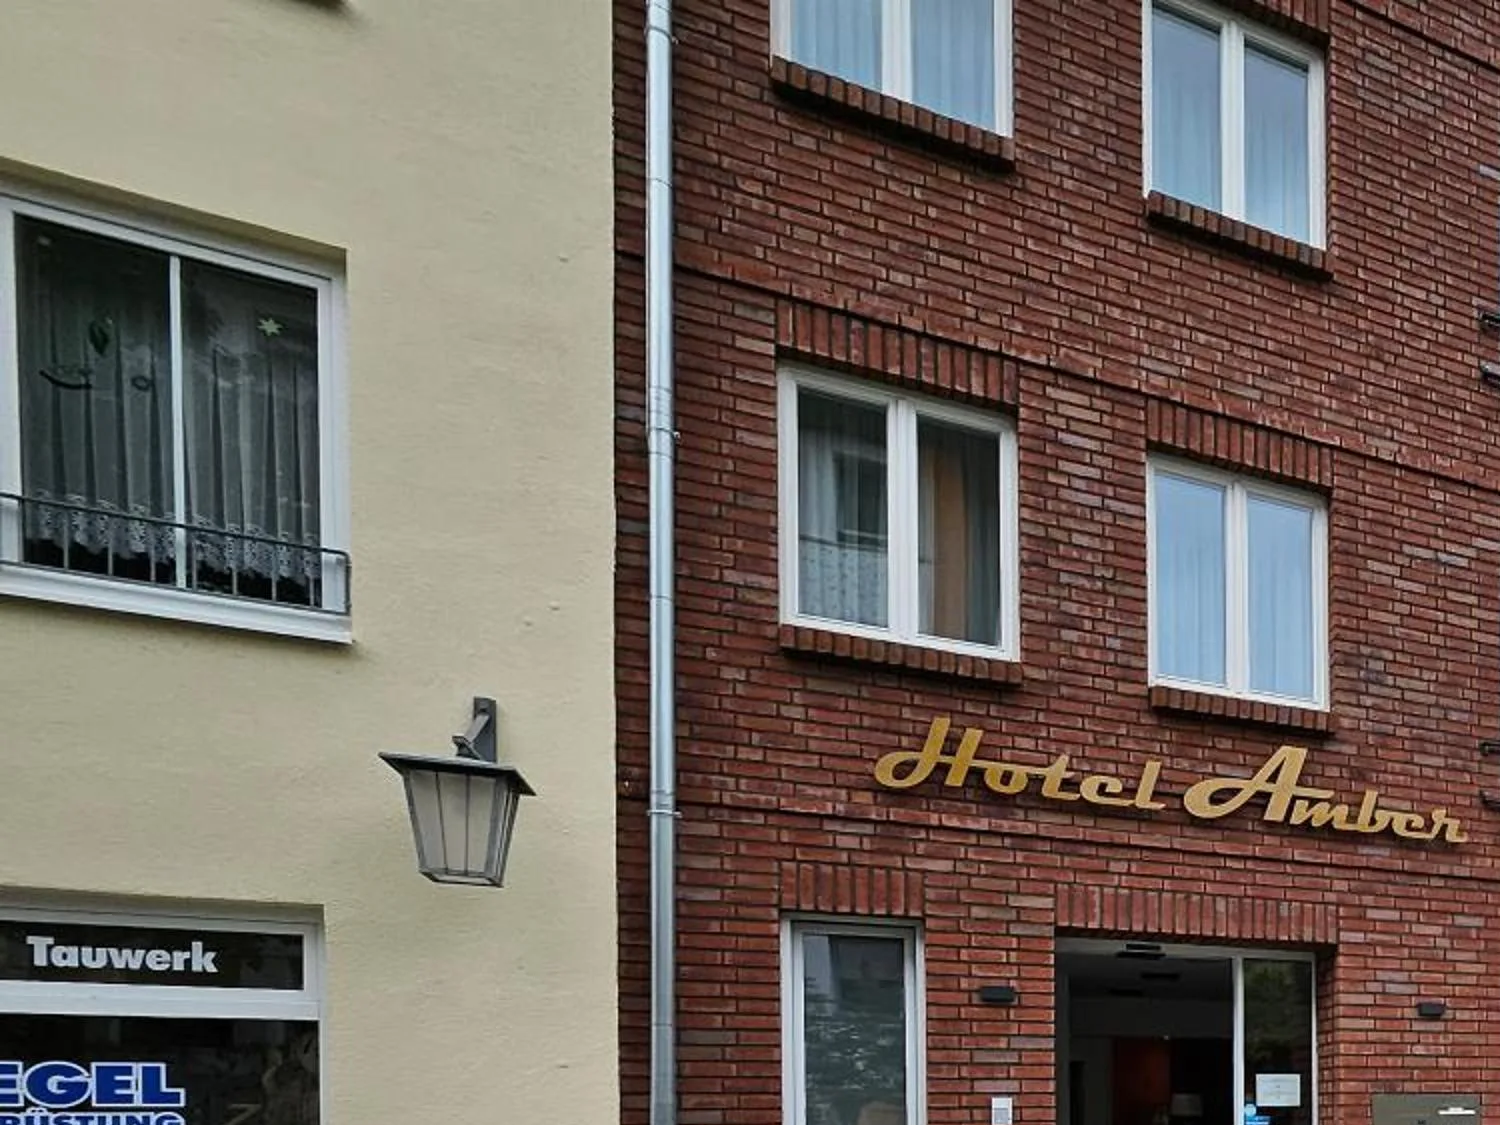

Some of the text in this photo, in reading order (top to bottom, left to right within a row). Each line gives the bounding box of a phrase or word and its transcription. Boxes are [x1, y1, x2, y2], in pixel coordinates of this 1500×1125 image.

[873, 716, 1469, 845] Hotel Amber
[26, 935, 219, 974] Tauwerk
